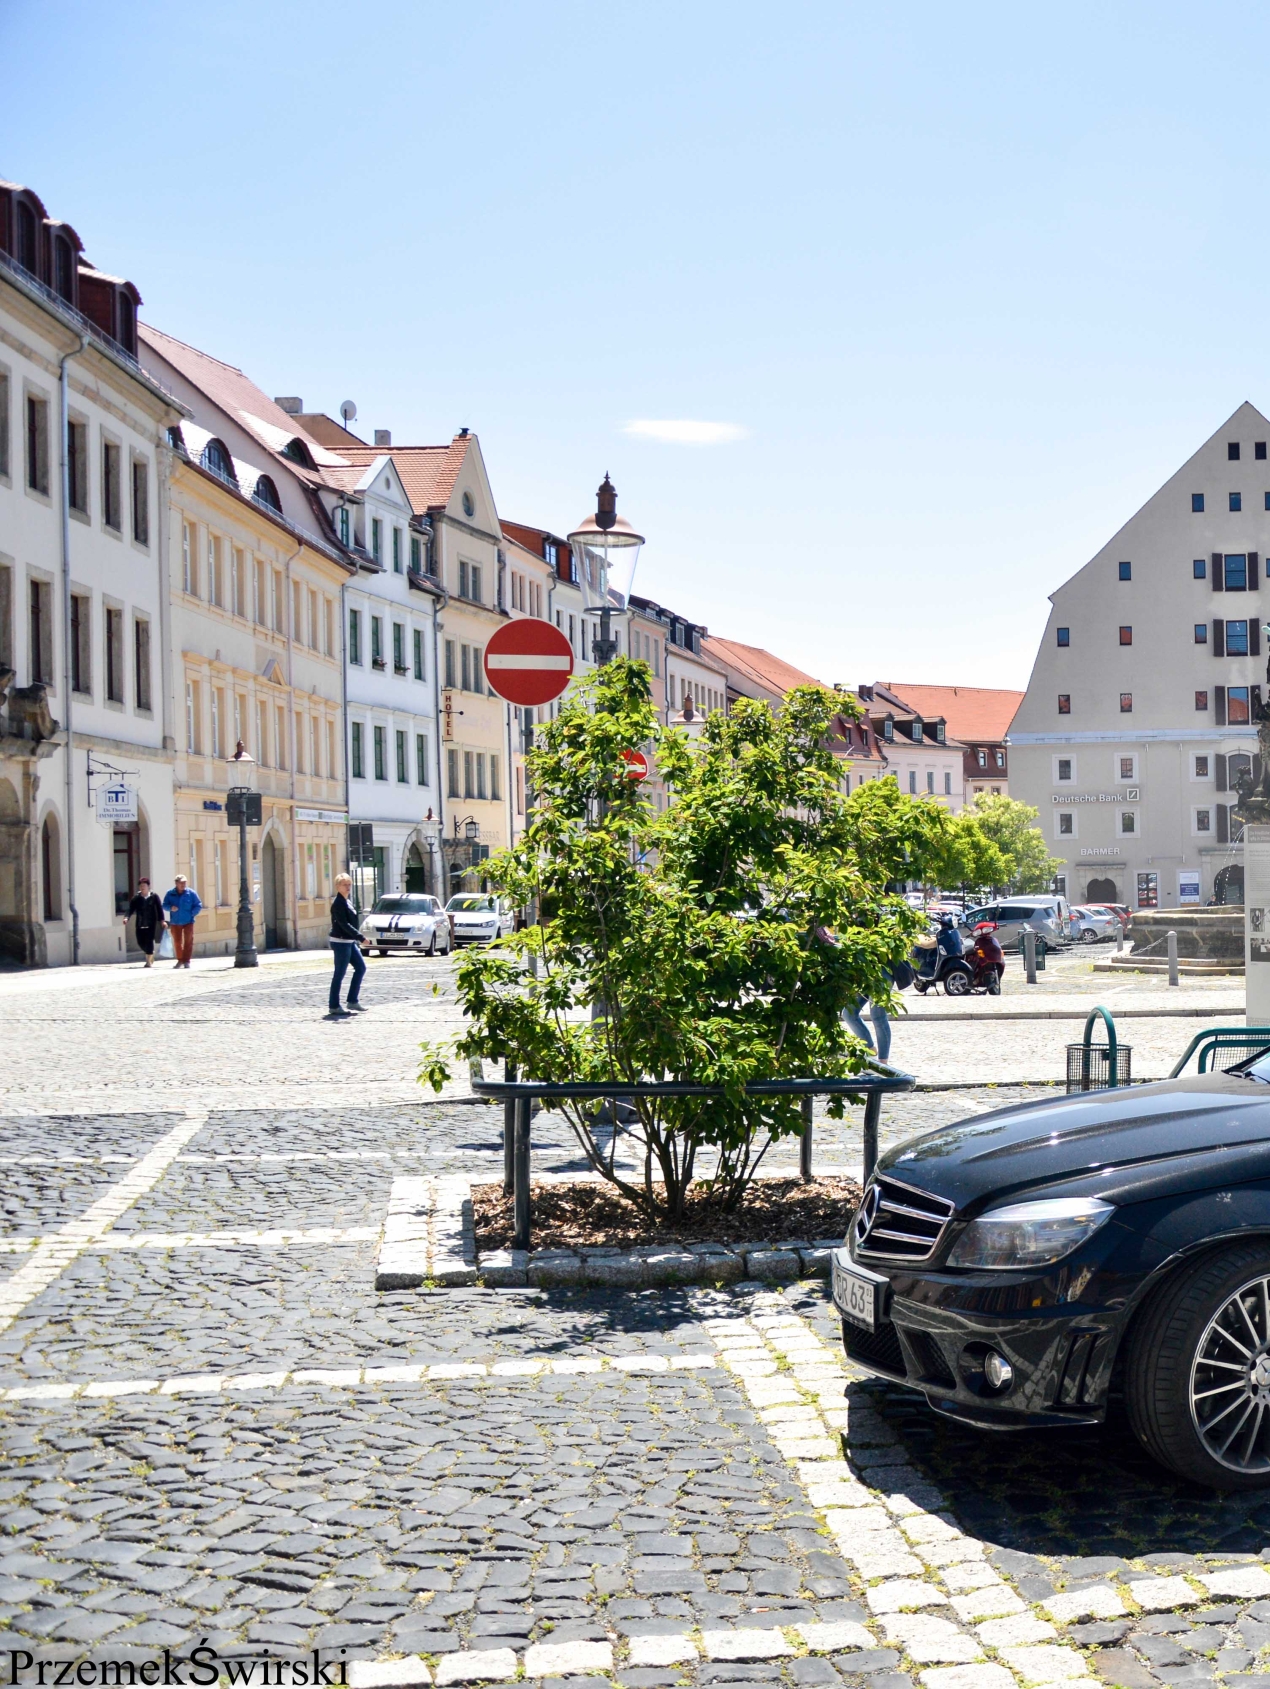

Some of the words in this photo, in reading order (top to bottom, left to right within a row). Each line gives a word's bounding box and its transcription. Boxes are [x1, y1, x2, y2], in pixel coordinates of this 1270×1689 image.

[1051, 794, 1097, 804] Deutsche
[1099, 793, 1123, 802] Bank
[1080, 848, 1120, 856] BARMER
[850, 1282, 866, 1314] 63
